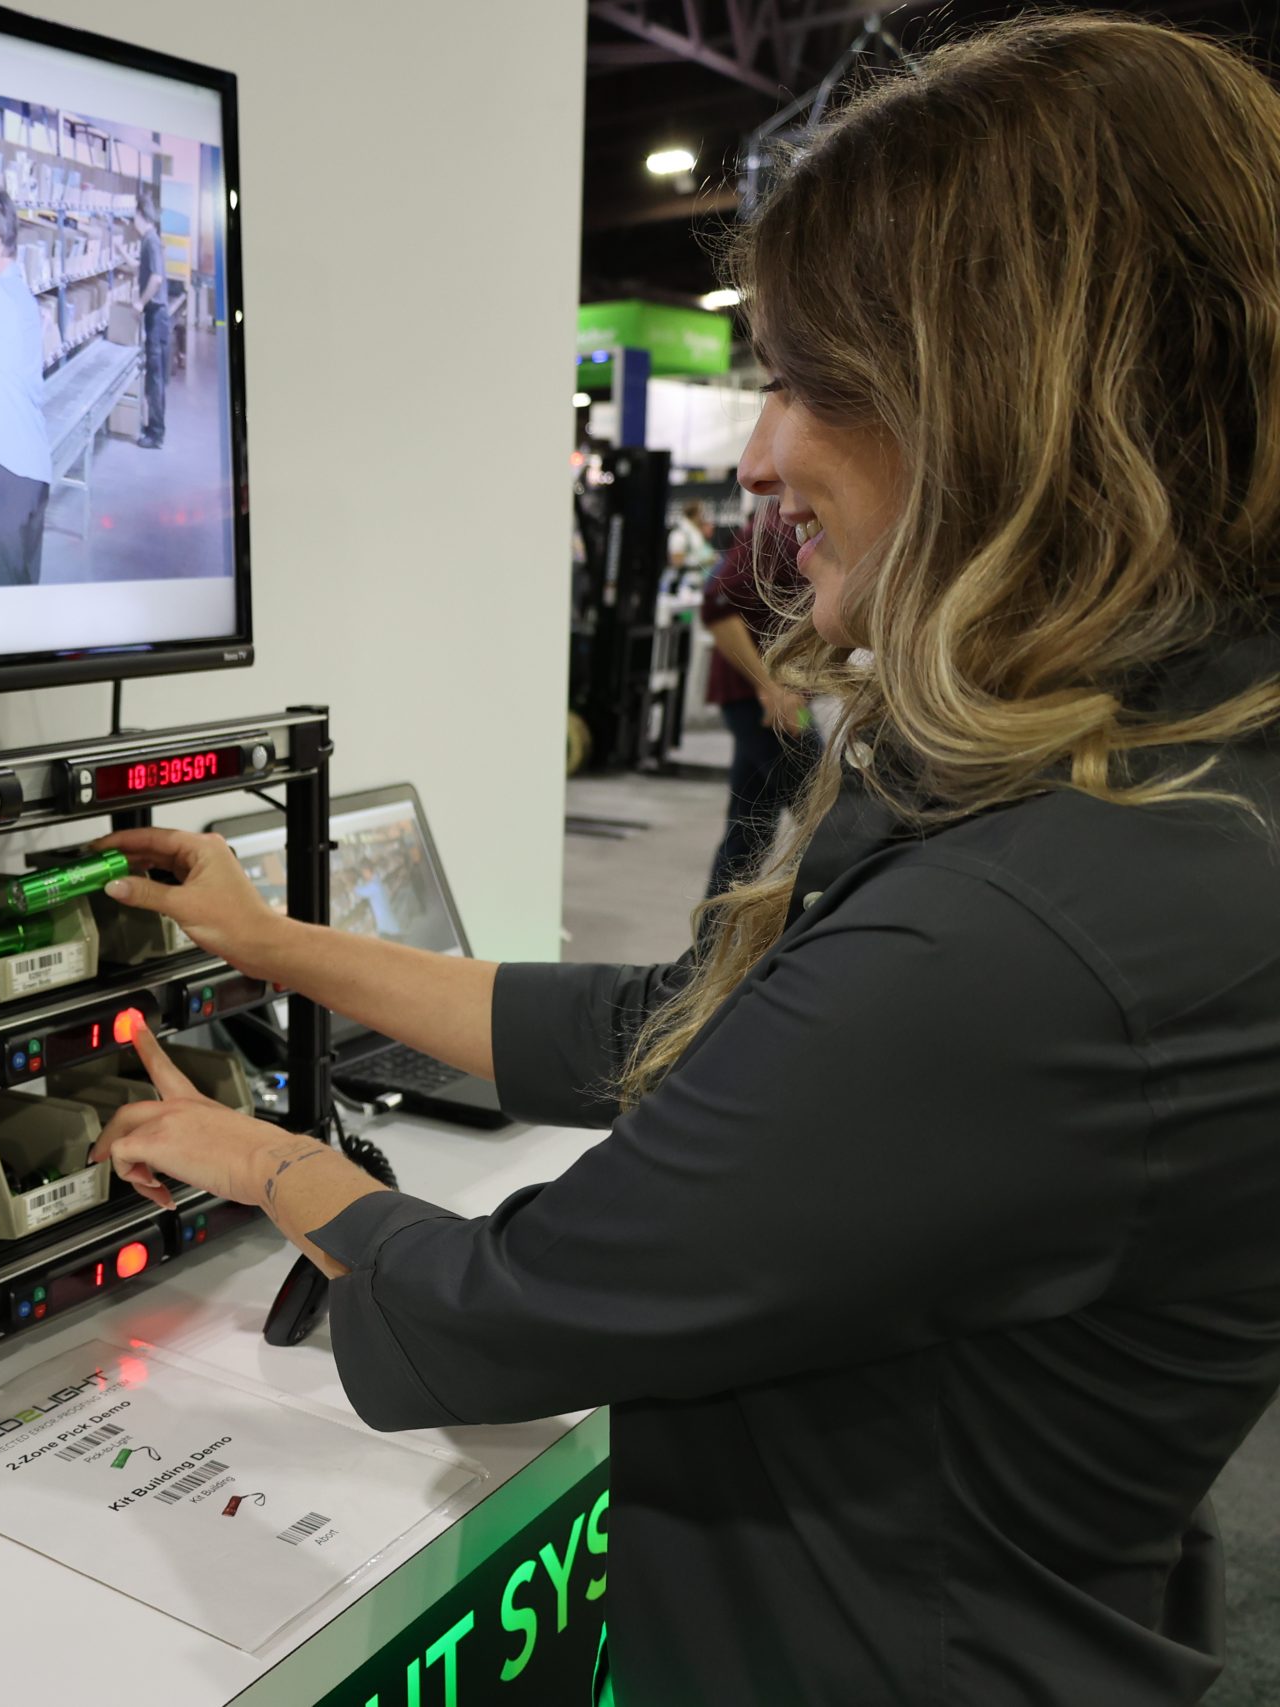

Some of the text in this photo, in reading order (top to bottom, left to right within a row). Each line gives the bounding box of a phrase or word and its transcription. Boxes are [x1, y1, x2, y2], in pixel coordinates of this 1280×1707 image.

[92, 1023, 99, 1048] 1
[96, 1262, 103, 1287] 1
[6, 1400, 131, 1471] 2-Zone Pick Demo
[83, 1434, 134, 1463] Pick-to-Light
[108, 1435, 232, 1512] Kit Building Demo
[189, 1475, 236, 1504] Kit Building
[314, 1528, 340, 1546] Abort
